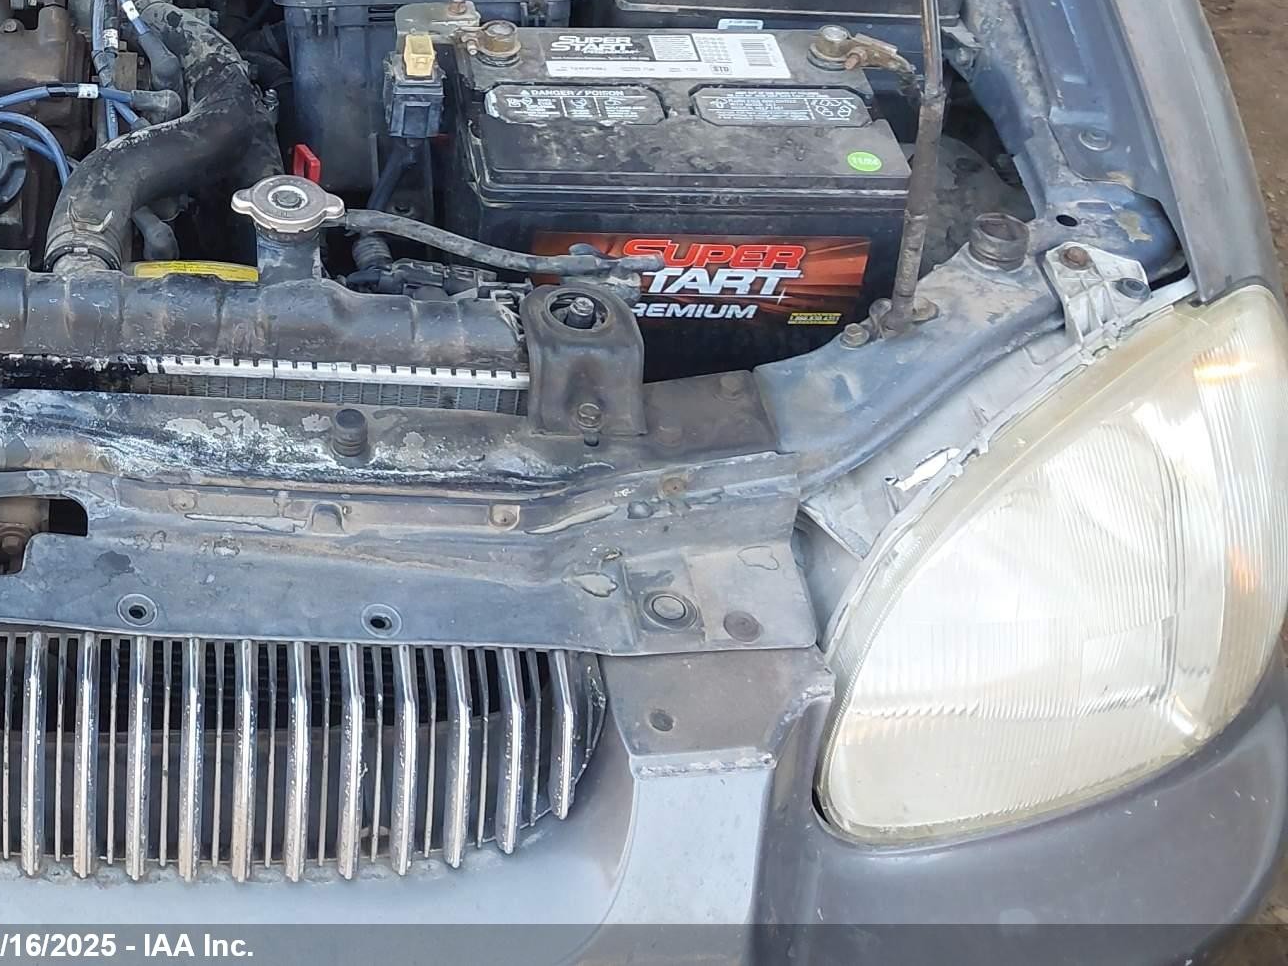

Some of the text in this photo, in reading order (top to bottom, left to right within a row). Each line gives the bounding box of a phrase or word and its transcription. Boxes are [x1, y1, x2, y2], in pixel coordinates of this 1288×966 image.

[551, 42, 633, 52] START
[559, 35, 632, 44] SUPER
[623, 239, 806, 270] SUPER
[642, 268, 803, 295] TART
[631, 303, 758, 319] REMIUM
